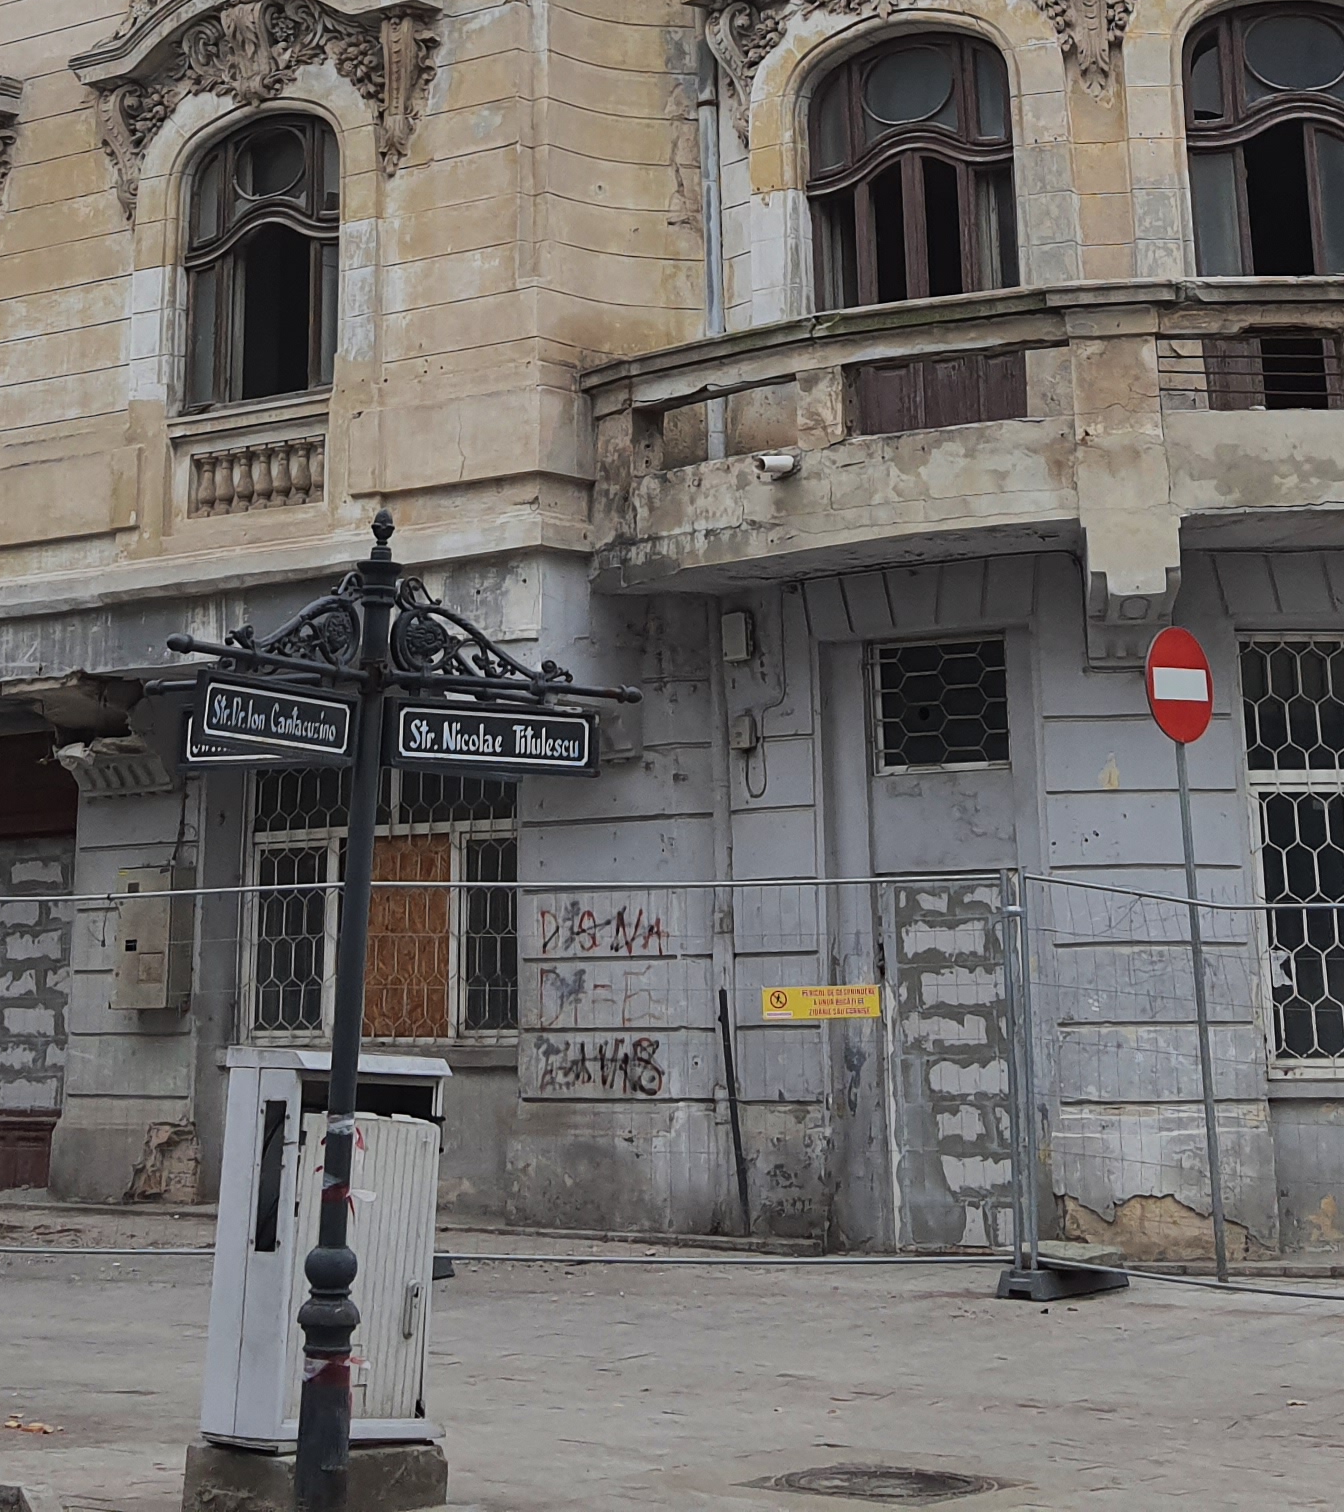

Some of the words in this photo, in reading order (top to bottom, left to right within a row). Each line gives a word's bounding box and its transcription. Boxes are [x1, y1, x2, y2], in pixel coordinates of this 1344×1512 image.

[270, 702, 337, 742] Cantacuzino
[409, 719, 438, 750] Str.
[442, 721, 503, 753] Nicolae
[512, 724, 579, 758] Titulescu
